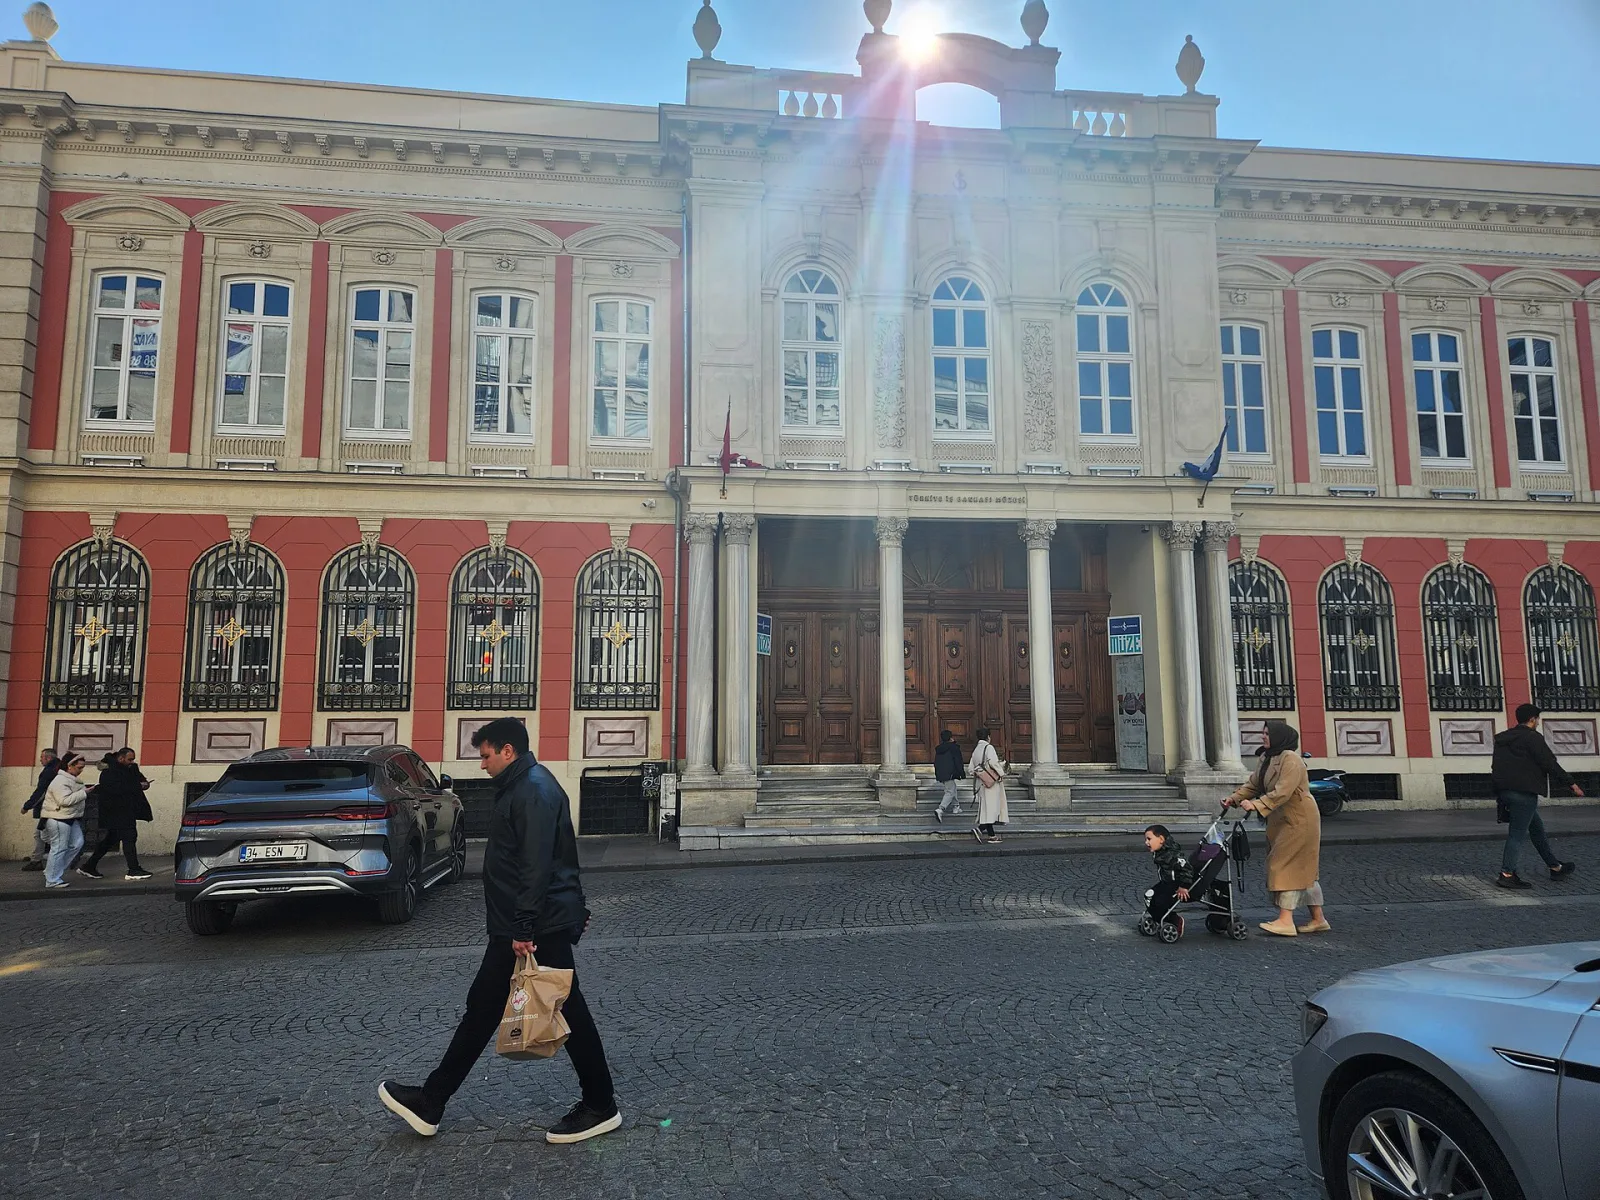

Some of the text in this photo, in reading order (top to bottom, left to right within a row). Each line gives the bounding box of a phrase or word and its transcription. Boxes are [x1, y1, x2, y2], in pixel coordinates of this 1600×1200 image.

[1110, 634, 1141, 654] MÜZE
[247, 845, 304, 858] 34 ESN 71
